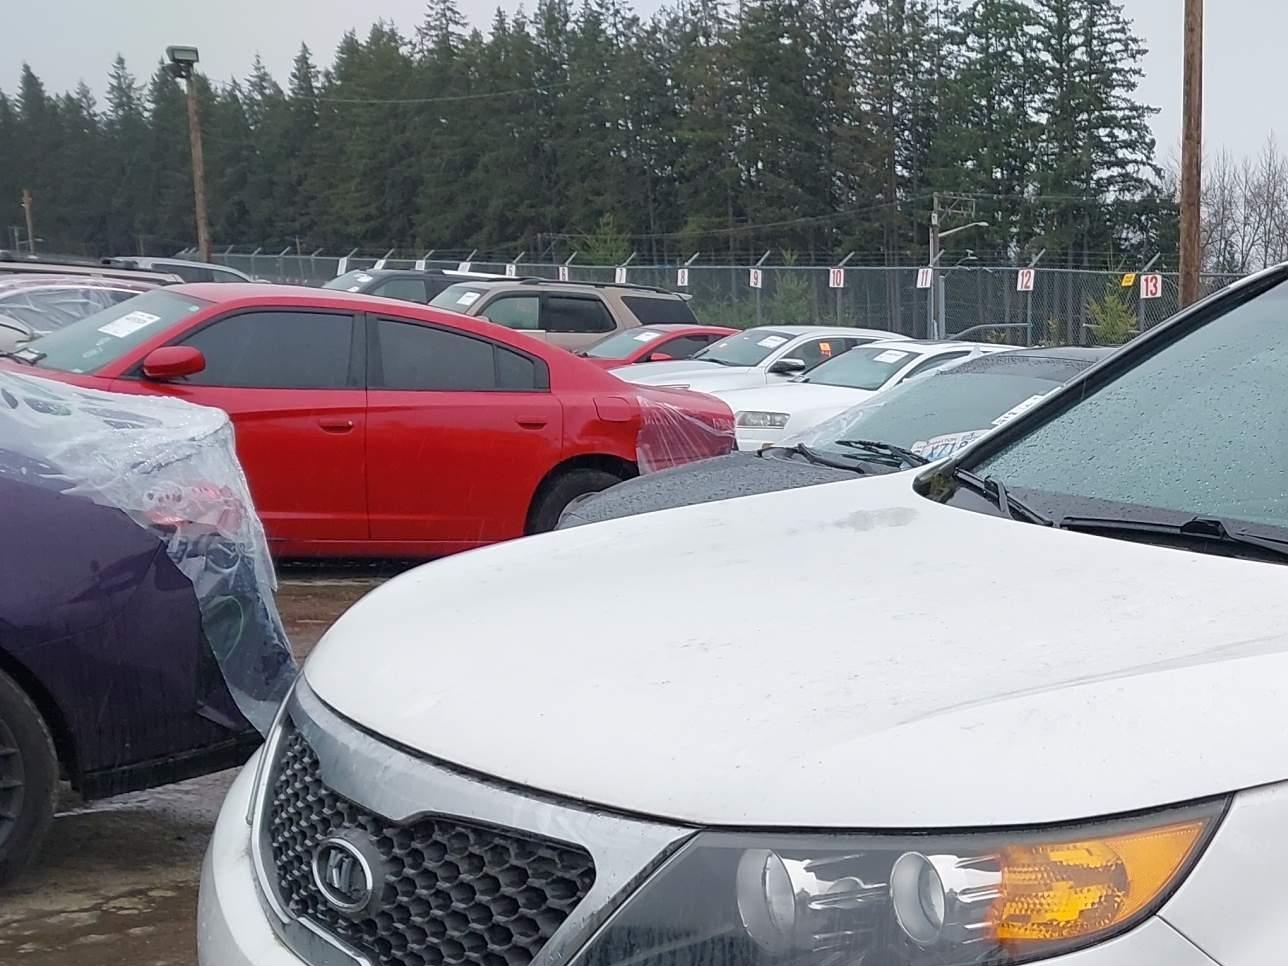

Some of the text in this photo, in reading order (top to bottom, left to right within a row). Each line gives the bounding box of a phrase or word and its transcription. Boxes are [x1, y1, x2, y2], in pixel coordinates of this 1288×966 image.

[753, 272, 758, 286] 9
[832, 270, 841, 286] 10
[921, 271, 928, 286] 11
[1020, 271, 1032, 289] 12
[1144, 276, 1158, 296] 13
